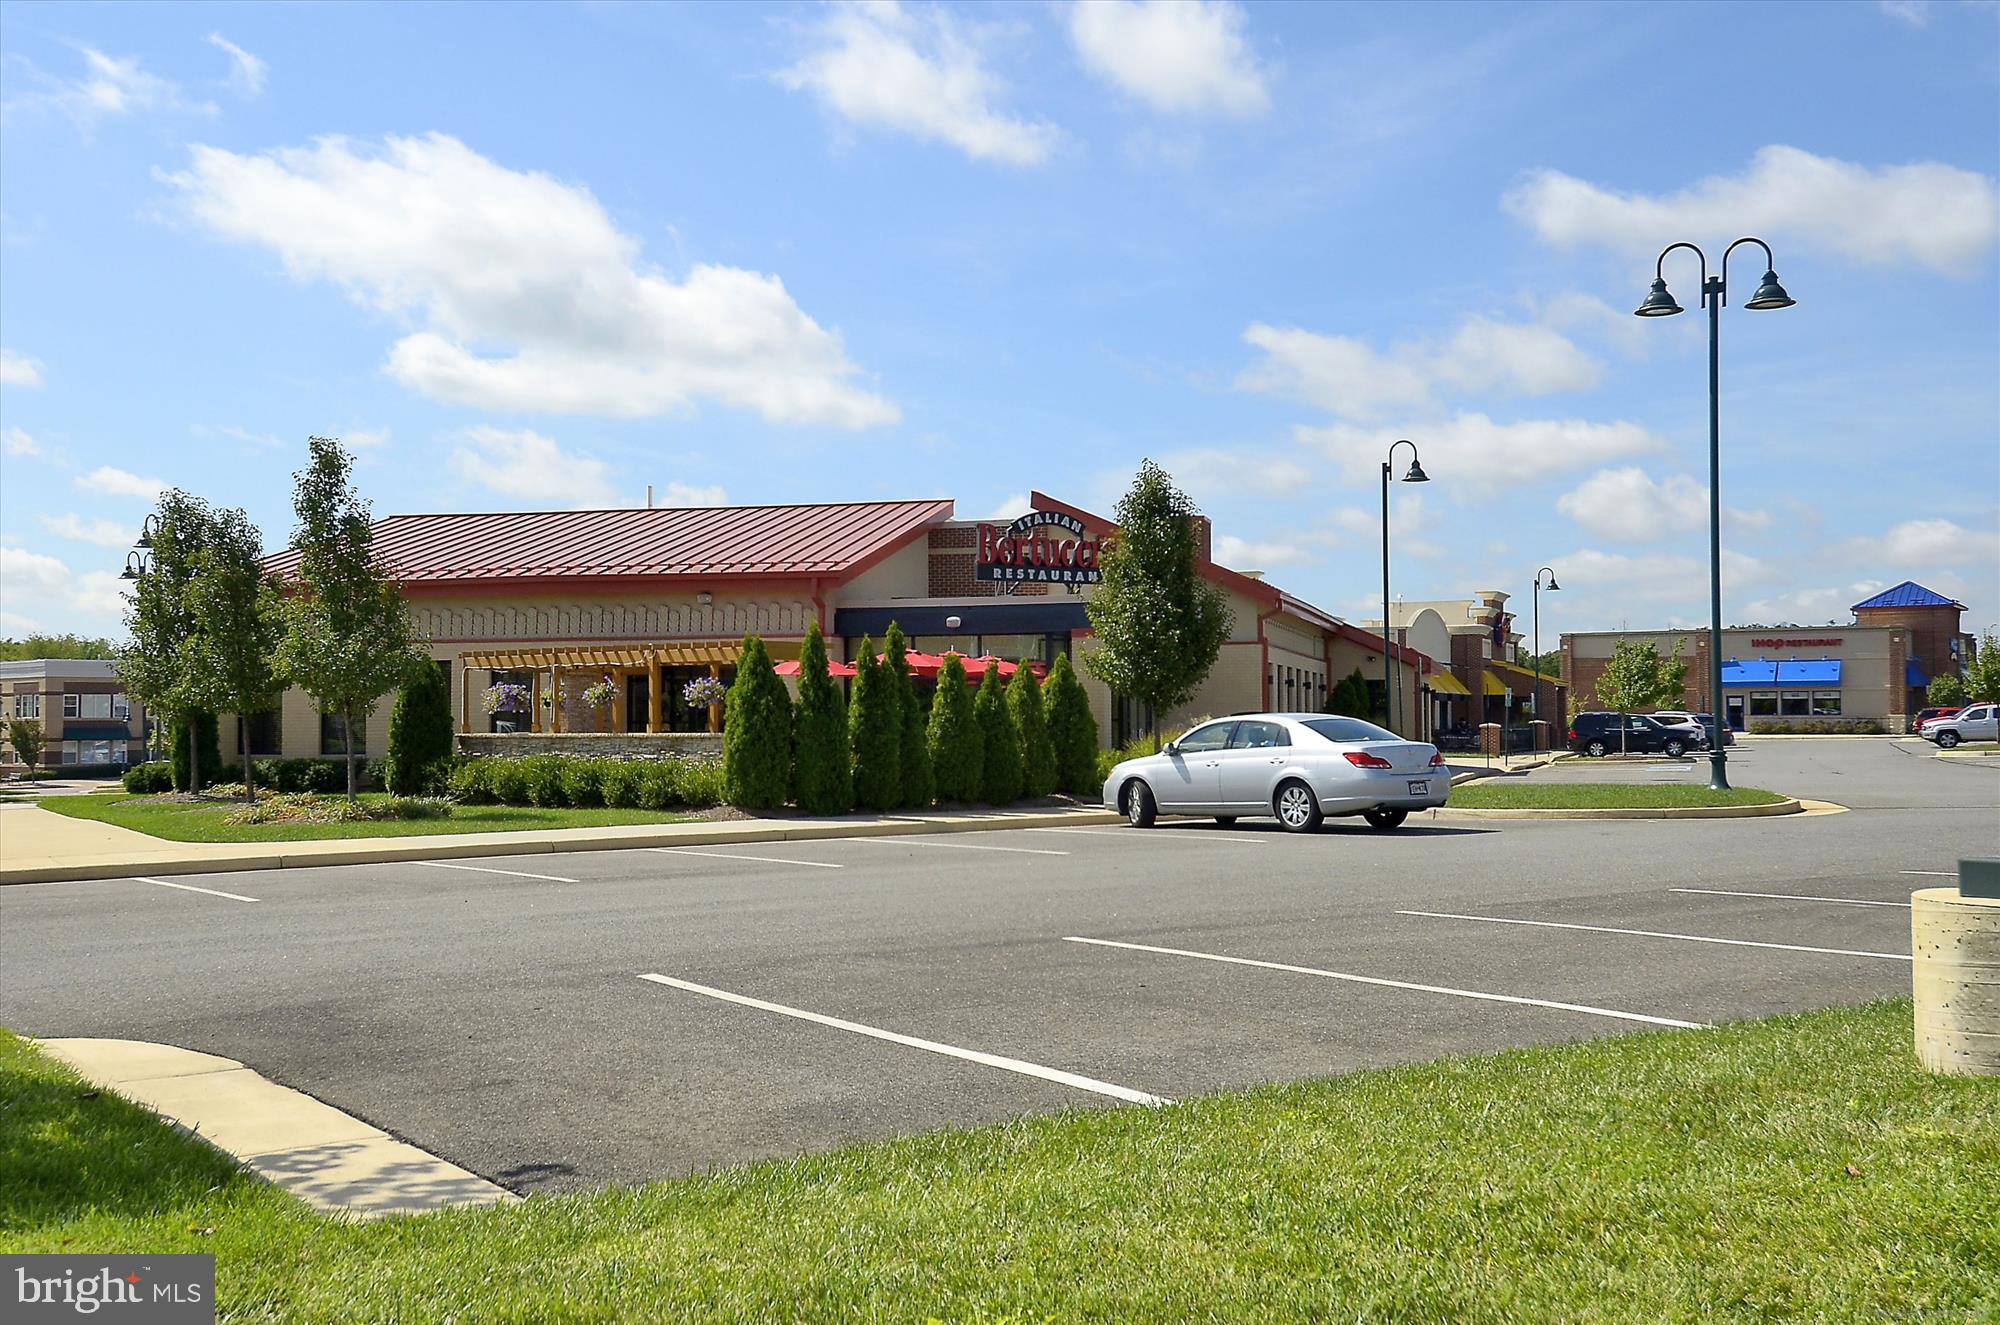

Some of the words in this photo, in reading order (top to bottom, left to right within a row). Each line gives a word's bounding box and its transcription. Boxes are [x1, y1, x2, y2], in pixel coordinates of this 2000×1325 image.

[1018, 512, 1082, 534] ITALIAN
[976, 523, 1102, 568] Bertucci
[993, 568, 1099, 581] RESTAURAN
